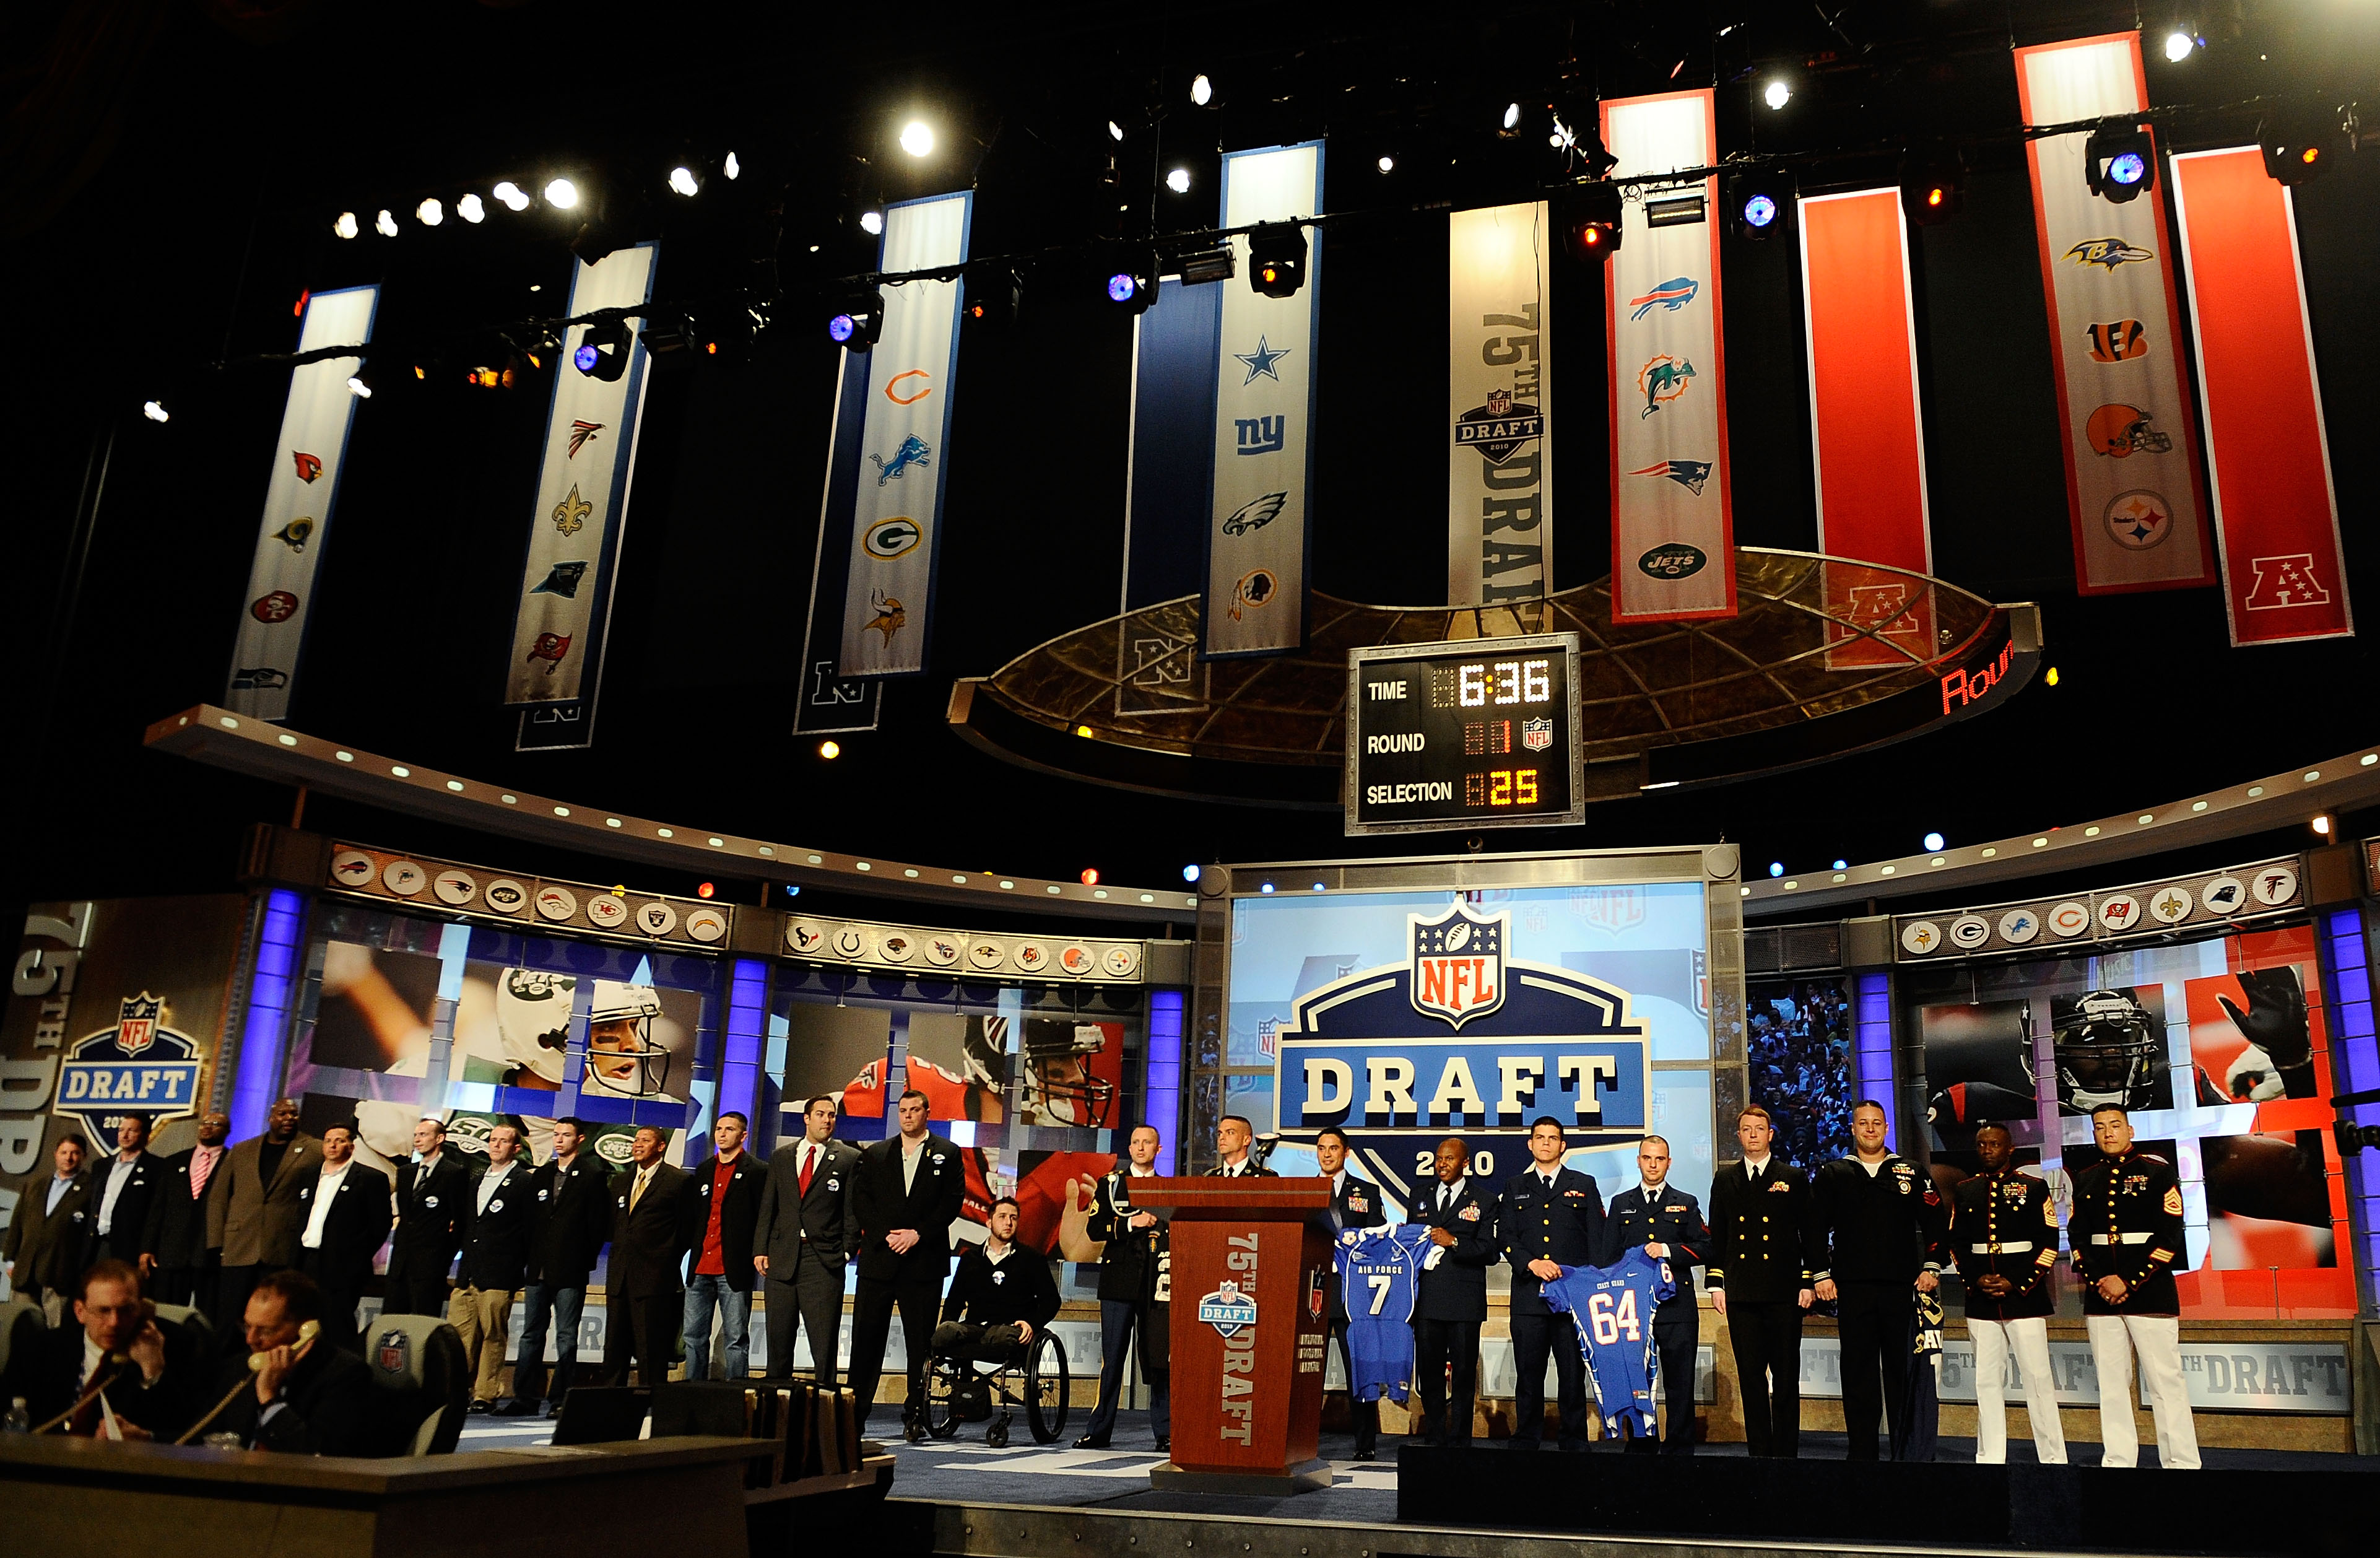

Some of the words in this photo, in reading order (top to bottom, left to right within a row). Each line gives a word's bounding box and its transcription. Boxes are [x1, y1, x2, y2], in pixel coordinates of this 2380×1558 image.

[1482, 303, 1539, 401] 75TH
[1488, 400, 1509, 413] NFL
[1461, 419, 1539, 440] DRAFT
[1490, 443, 1509, 451] 2010
[1648, 555, 1695, 568] JETS
[1368, 681, 1407, 700] TIME
[1459, 659, 1549, 707] 6:36
[1368, 733, 1425, 754] ROUND
[1504, 720, 1511, 753] 1
[1527, 732, 1549, 746] NFL
[1367, 781, 1452, 804] SELECTION
[1490, 769, 1537, 805] 25
[1422, 959, 1493, 1011] NFL
[119, 1021, 152, 1047] NFL
[66, 1069, 187, 1099] DRAFT
[1302, 1055, 1615, 1114] DRAFT
[1228, 1233, 1258, 1292] 75TH
[1358, 1266, 1372, 1274] AIR
[1376, 1266, 1402, 1274] FORCE
[1222, 1292, 1235, 1301] NFL
[1368, 1275, 1391, 1315] 7
[1204, 1308, 1251, 1321] DRAFT
[1588, 1289, 1640, 1345] 64
[1221, 1328, 1255, 1446] DRAFT
[2205, 1354, 2347, 1396] DRAFT
